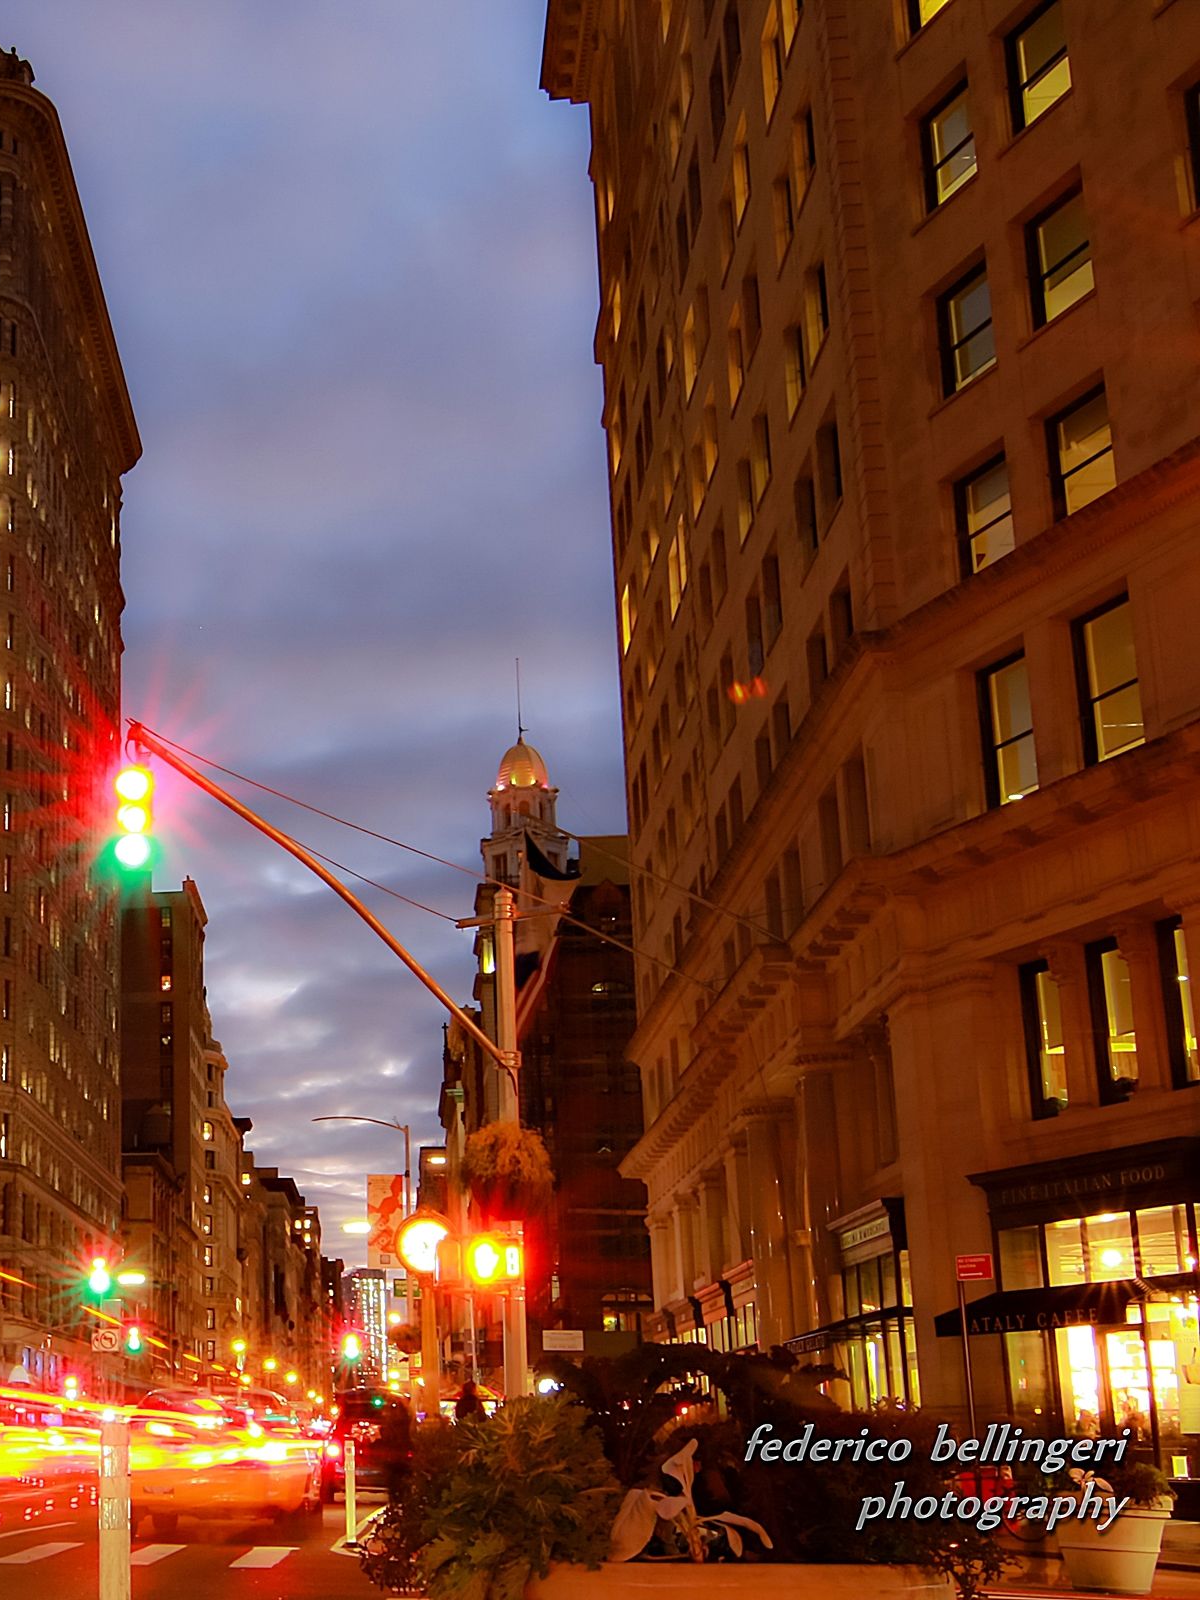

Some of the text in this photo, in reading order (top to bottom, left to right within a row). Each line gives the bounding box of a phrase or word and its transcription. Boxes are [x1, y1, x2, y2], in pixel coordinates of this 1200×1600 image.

[1001, 1164, 1166, 1204] FINE ITALIAN FOOD
[969, 1307, 1099, 1333] ATALY CAFFE
